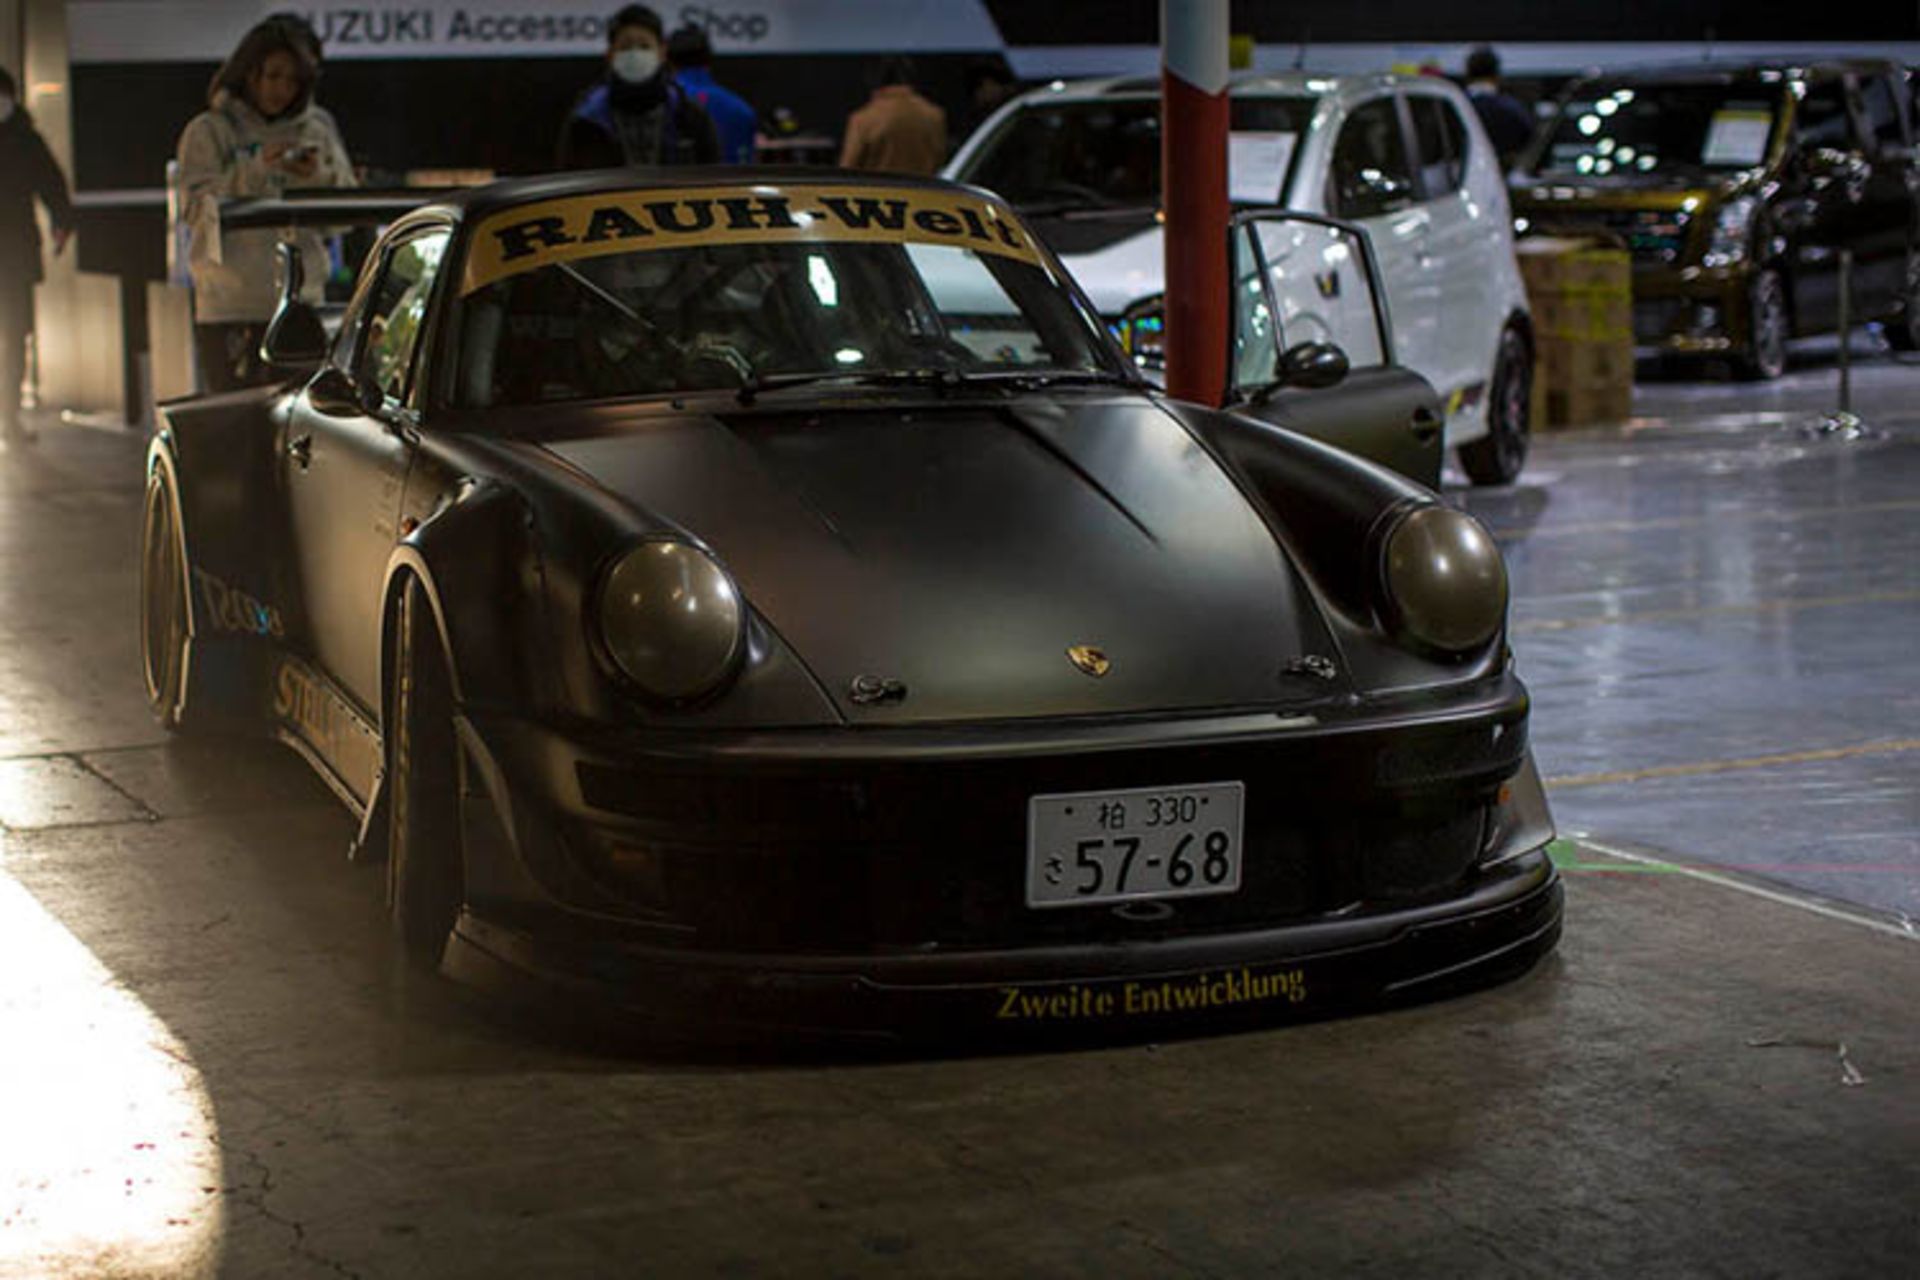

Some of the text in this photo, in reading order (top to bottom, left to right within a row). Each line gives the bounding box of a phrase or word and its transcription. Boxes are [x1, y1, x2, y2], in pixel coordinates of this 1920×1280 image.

[448, 9, 609, 43] Accesso
[495, 197, 1021, 259] RAUH-Welt
[1098, 795, 1196, 829] 柏 330
[1044, 830, 1229, 895] さ 57-68
[997, 967, 1307, 1018] Zweite Entwicklung
